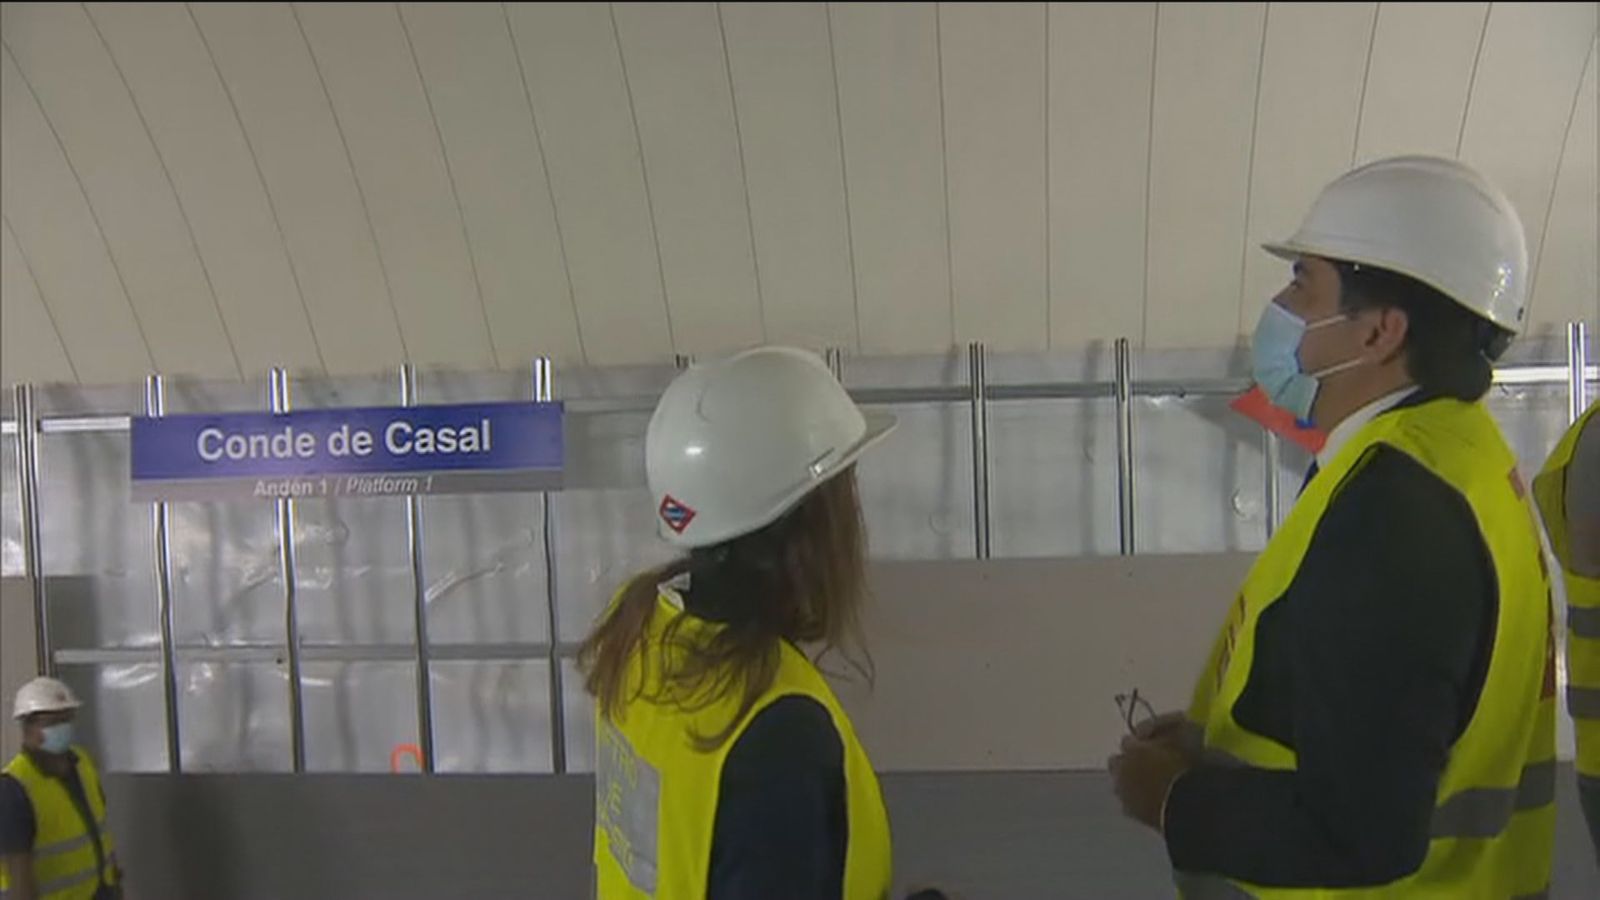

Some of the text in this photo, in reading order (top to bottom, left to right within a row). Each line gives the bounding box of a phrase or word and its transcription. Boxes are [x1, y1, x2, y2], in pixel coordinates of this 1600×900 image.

[197, 419, 491, 461] Conde de Casal
[253, 478, 313, 496] Andén
[319, 479, 328, 495] 1
[345, 476, 418, 493] Platform
[425, 475, 433, 491] 1
